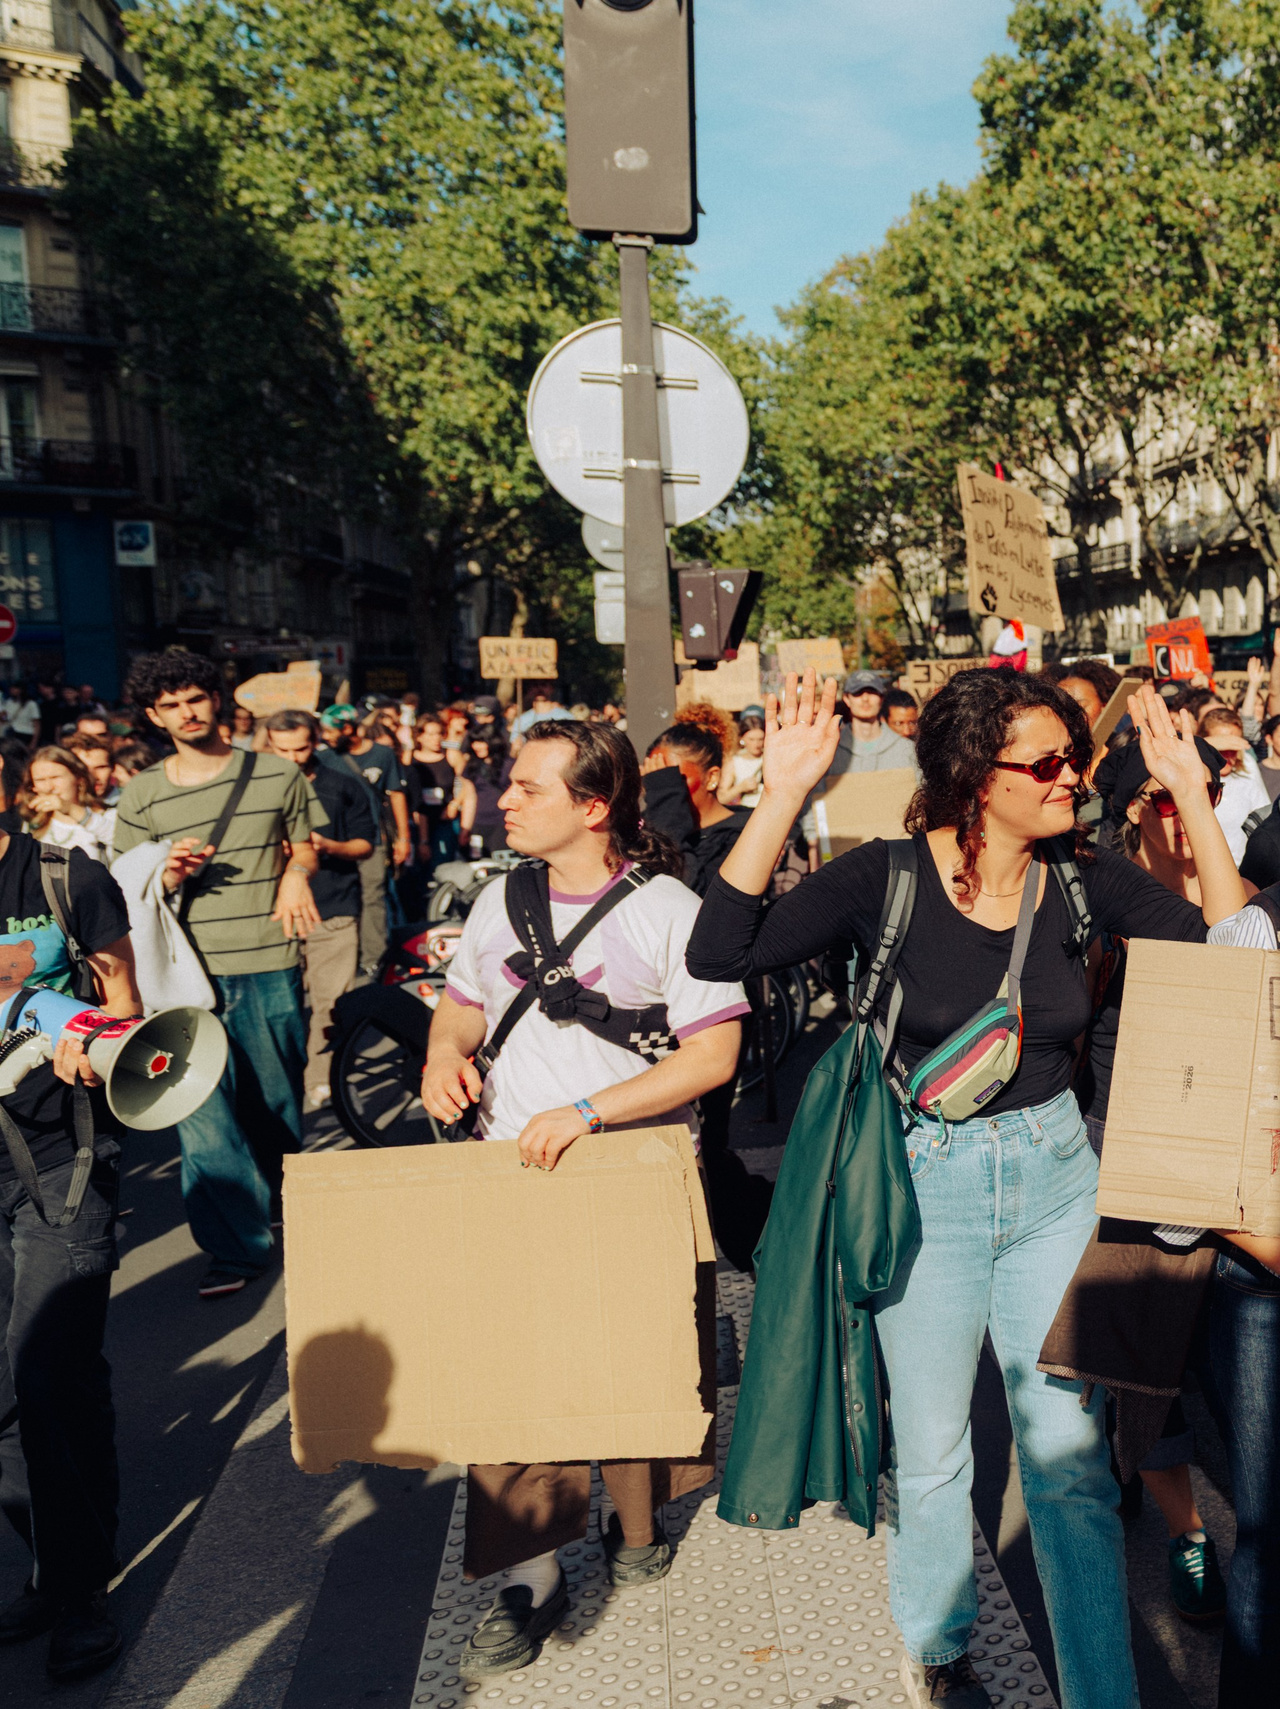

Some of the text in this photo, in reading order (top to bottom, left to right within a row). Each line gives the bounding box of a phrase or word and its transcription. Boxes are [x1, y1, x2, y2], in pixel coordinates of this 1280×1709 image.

[485, 643, 550, 659] UN FLIC
[1185, 1065, 1194, 1090] 2026
